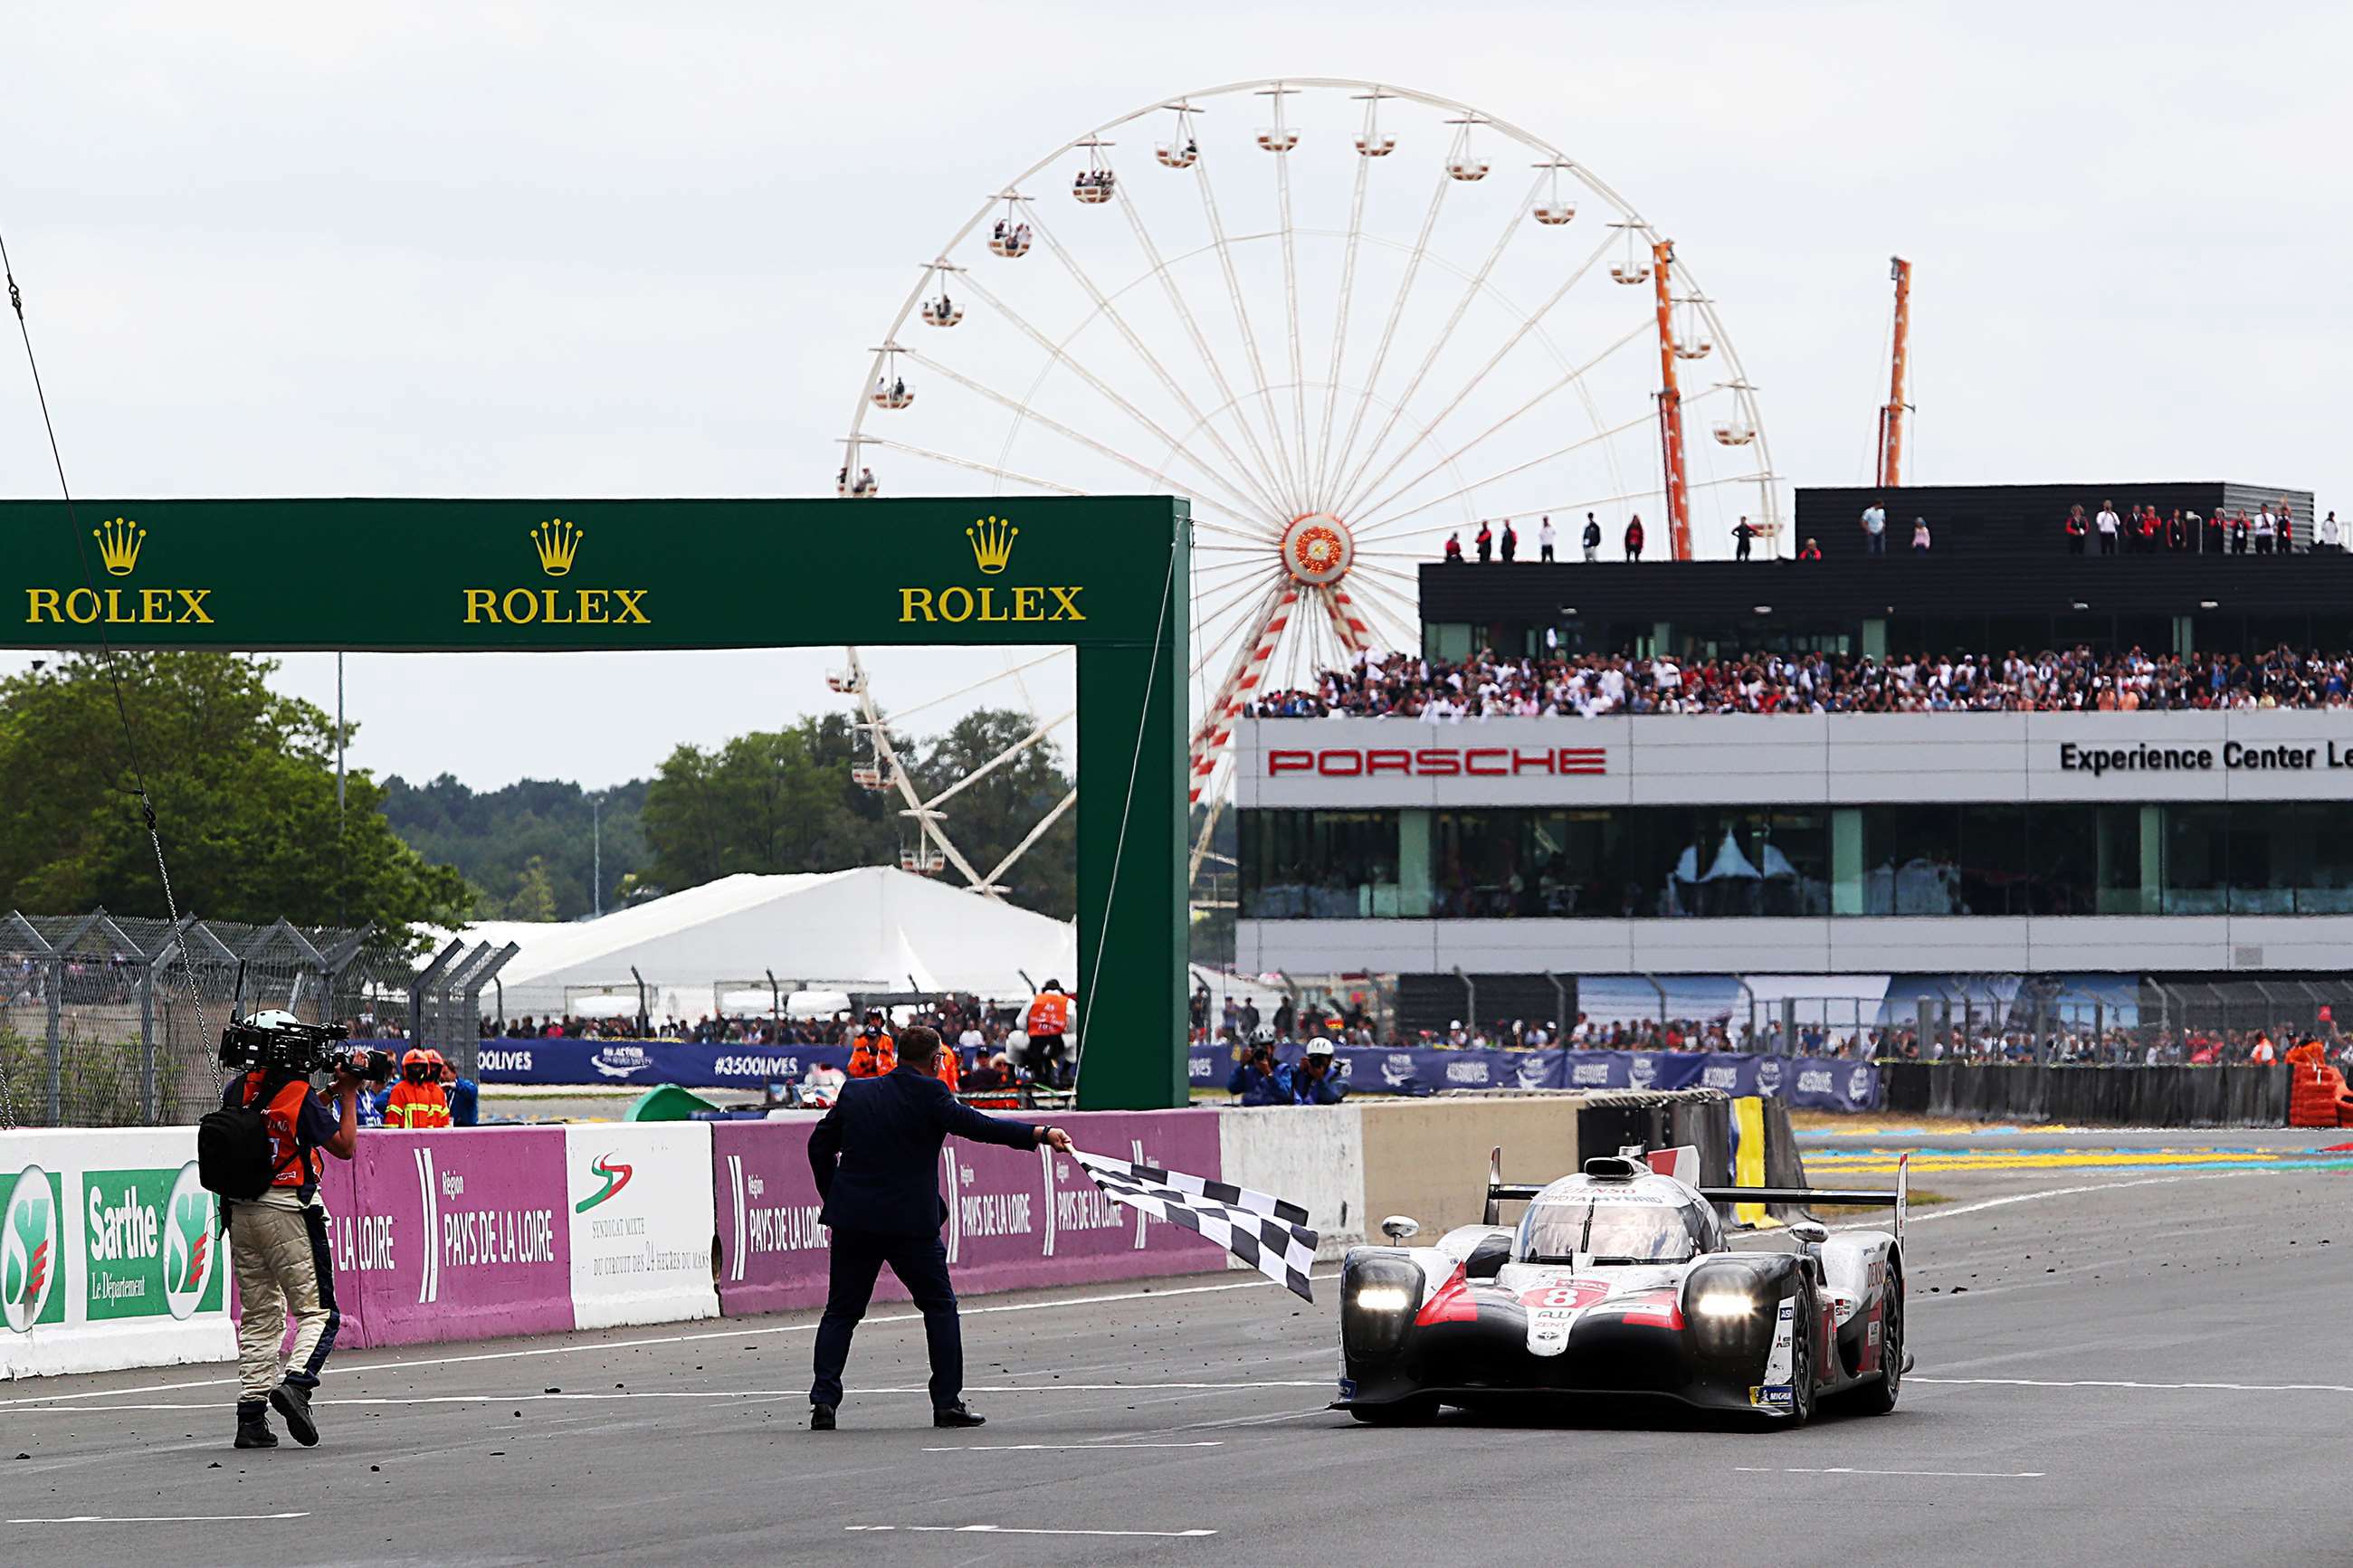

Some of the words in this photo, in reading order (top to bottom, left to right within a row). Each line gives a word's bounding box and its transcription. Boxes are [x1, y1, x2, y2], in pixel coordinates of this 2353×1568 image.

[25, 588, 214, 623] ROLEX
[463, 588, 651, 624] ROLEX
[899, 586, 1087, 622] ROLEX
[1269, 747, 1607, 777] PORSCHE
[2061, 742, 2213, 776] Experience
[2223, 740, 2316, 770] Center
[2327, 740, 2353, 769] Le
[443, 1170, 464, 1201] Région
[1564, 1186, 1636, 1194] DENSO
[89, 1185, 158, 1260] Sarthe
[592, 1219, 624, 1239] SYNDICAT
[625, 1217, 644, 1235] MIXTE
[961, 1196, 983, 1238] PAYS
[983, 1194, 996, 1236] DE
[996, 1193, 1008, 1235] LA
[1007, 1193, 1031, 1234] LOIRE
[1057, 1191, 1077, 1231] PAYS
[1078, 1190, 1089, 1231] DE
[1089, 1190, 1100, 1229] LA
[337, 1216, 356, 1271] LA
[357, 1215, 395, 1270] LOIRE
[444, 1212, 477, 1266] PAYS
[479, 1210, 497, 1264] DE
[499, 1210, 516, 1262] LA
[518, 1209, 554, 1262] LOIRE
[749, 1208, 774, 1253] PAYS
[774, 1207, 787, 1251] DE
[788, 1206, 801, 1250] LA
[594, 1257, 603, 1276] DU
[605, 1255, 631, 1275] CIRCUIT
[645, 1240, 654, 1271] 24
[656, 1250, 681, 1270] HEURES
[681, 1251, 691, 1269] DU
[92, 1272, 102, 1299] Le
[102, 1271, 145, 1307] Département
[1543, 1288, 1578, 1307] 8
[1559, 1280, 1607, 1290] TOTAL
